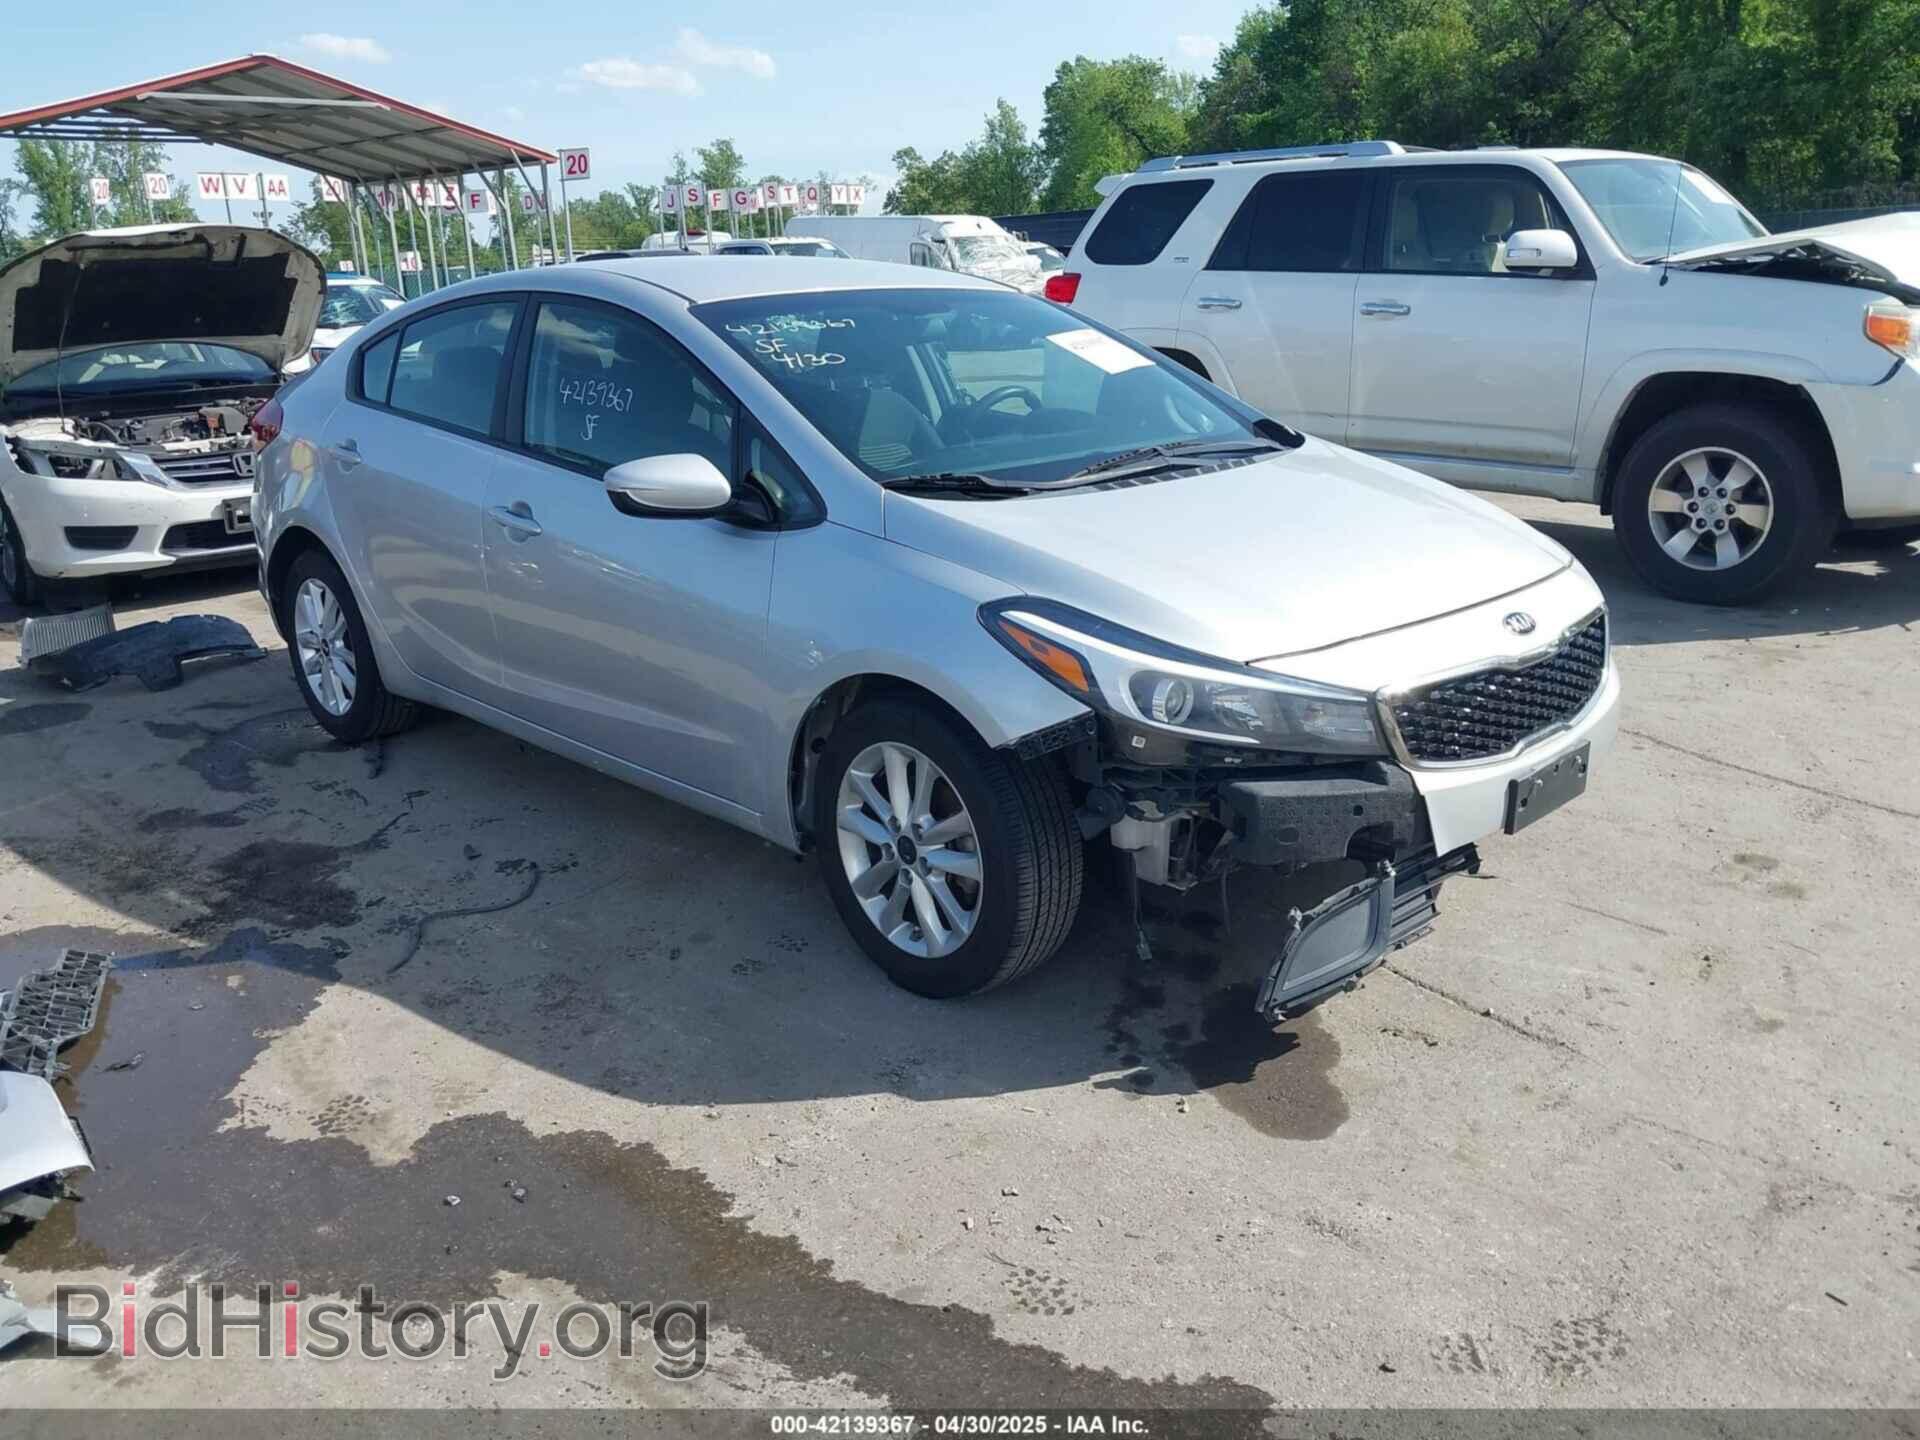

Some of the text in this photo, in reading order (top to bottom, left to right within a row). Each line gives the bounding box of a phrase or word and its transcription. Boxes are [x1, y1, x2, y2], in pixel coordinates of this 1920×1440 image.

[566, 153, 588, 175] 20
[95, 182, 108, 200] 20
[149, 175, 167, 194] 20
[200, 176, 220, 193] W
[233, 177, 247, 194] V
[267, 179, 287, 197] AA
[688, 188, 698, 202] S
[735, 191, 747, 205] G
[767, 185, 776, 200] S
[784, 188, 793, 201] T
[807, 187, 817, 201] Q
[835, 188, 844, 201] Y
[854, 188, 862, 201] X
[470, 193, 481, 209] F
[524, 195, 533, 210] D
[667, 194, 675, 208] J
[712, 193, 721, 208] F
[755, 338, 788, 353] SF
[559, 377, 633, 413] 42139367
